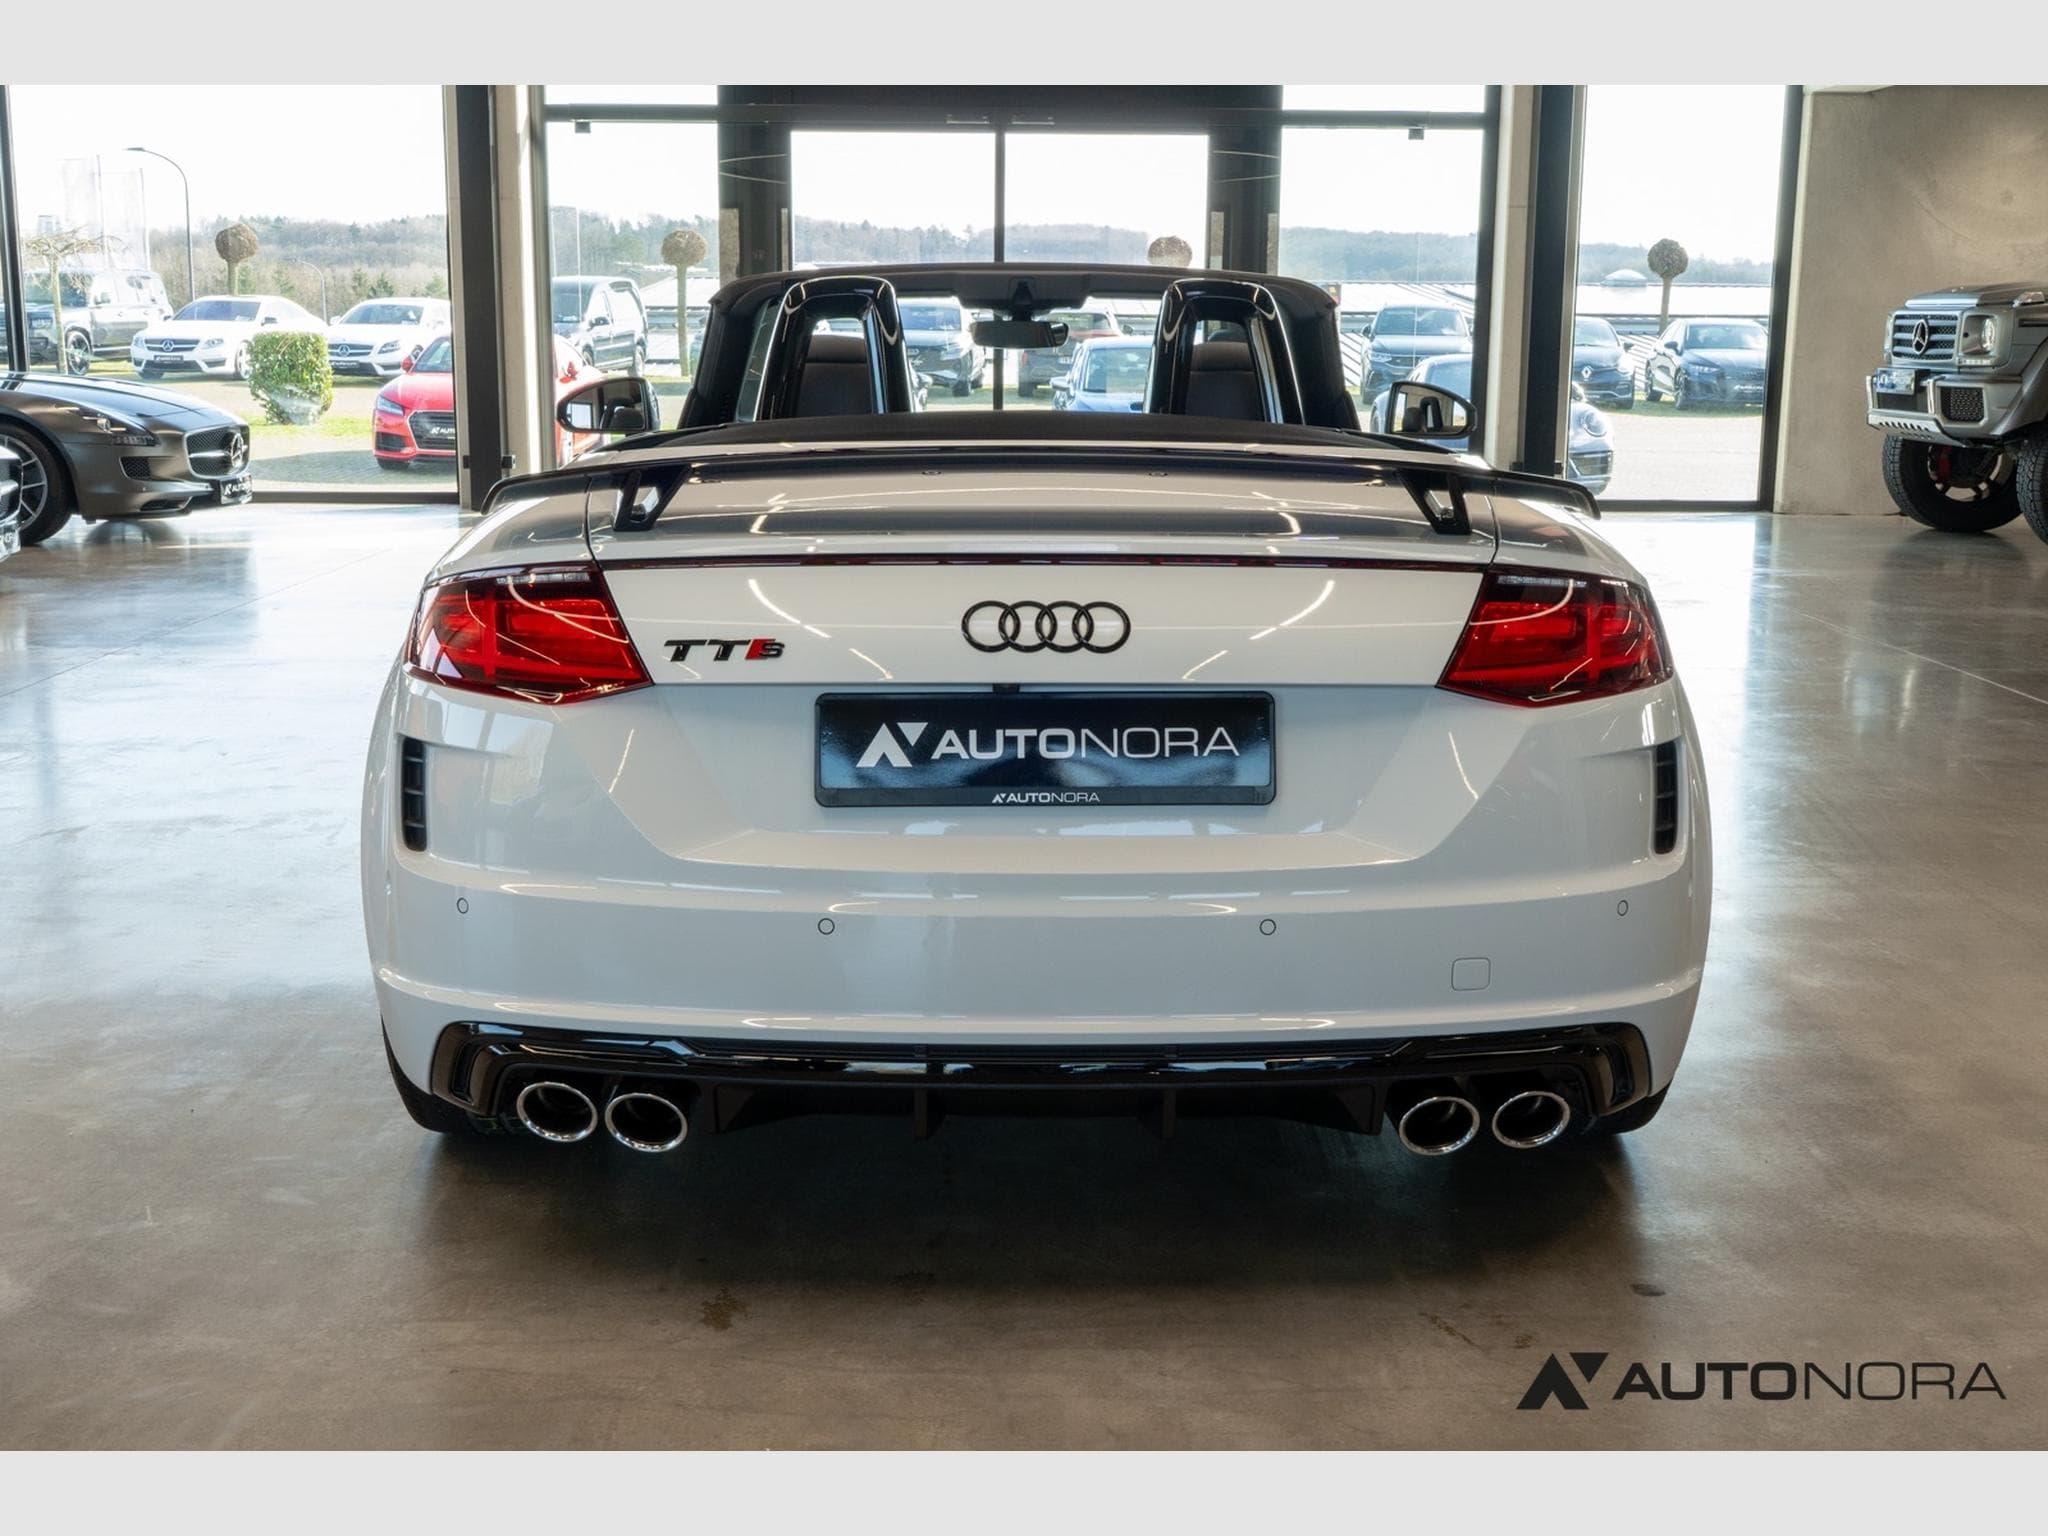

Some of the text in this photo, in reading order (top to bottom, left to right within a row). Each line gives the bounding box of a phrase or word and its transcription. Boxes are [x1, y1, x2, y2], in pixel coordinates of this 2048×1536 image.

[664, 638, 785, 662] TTS
[930, 726, 1240, 760] AUTONORA
[1006, 792, 1101, 803] AUTONORA
